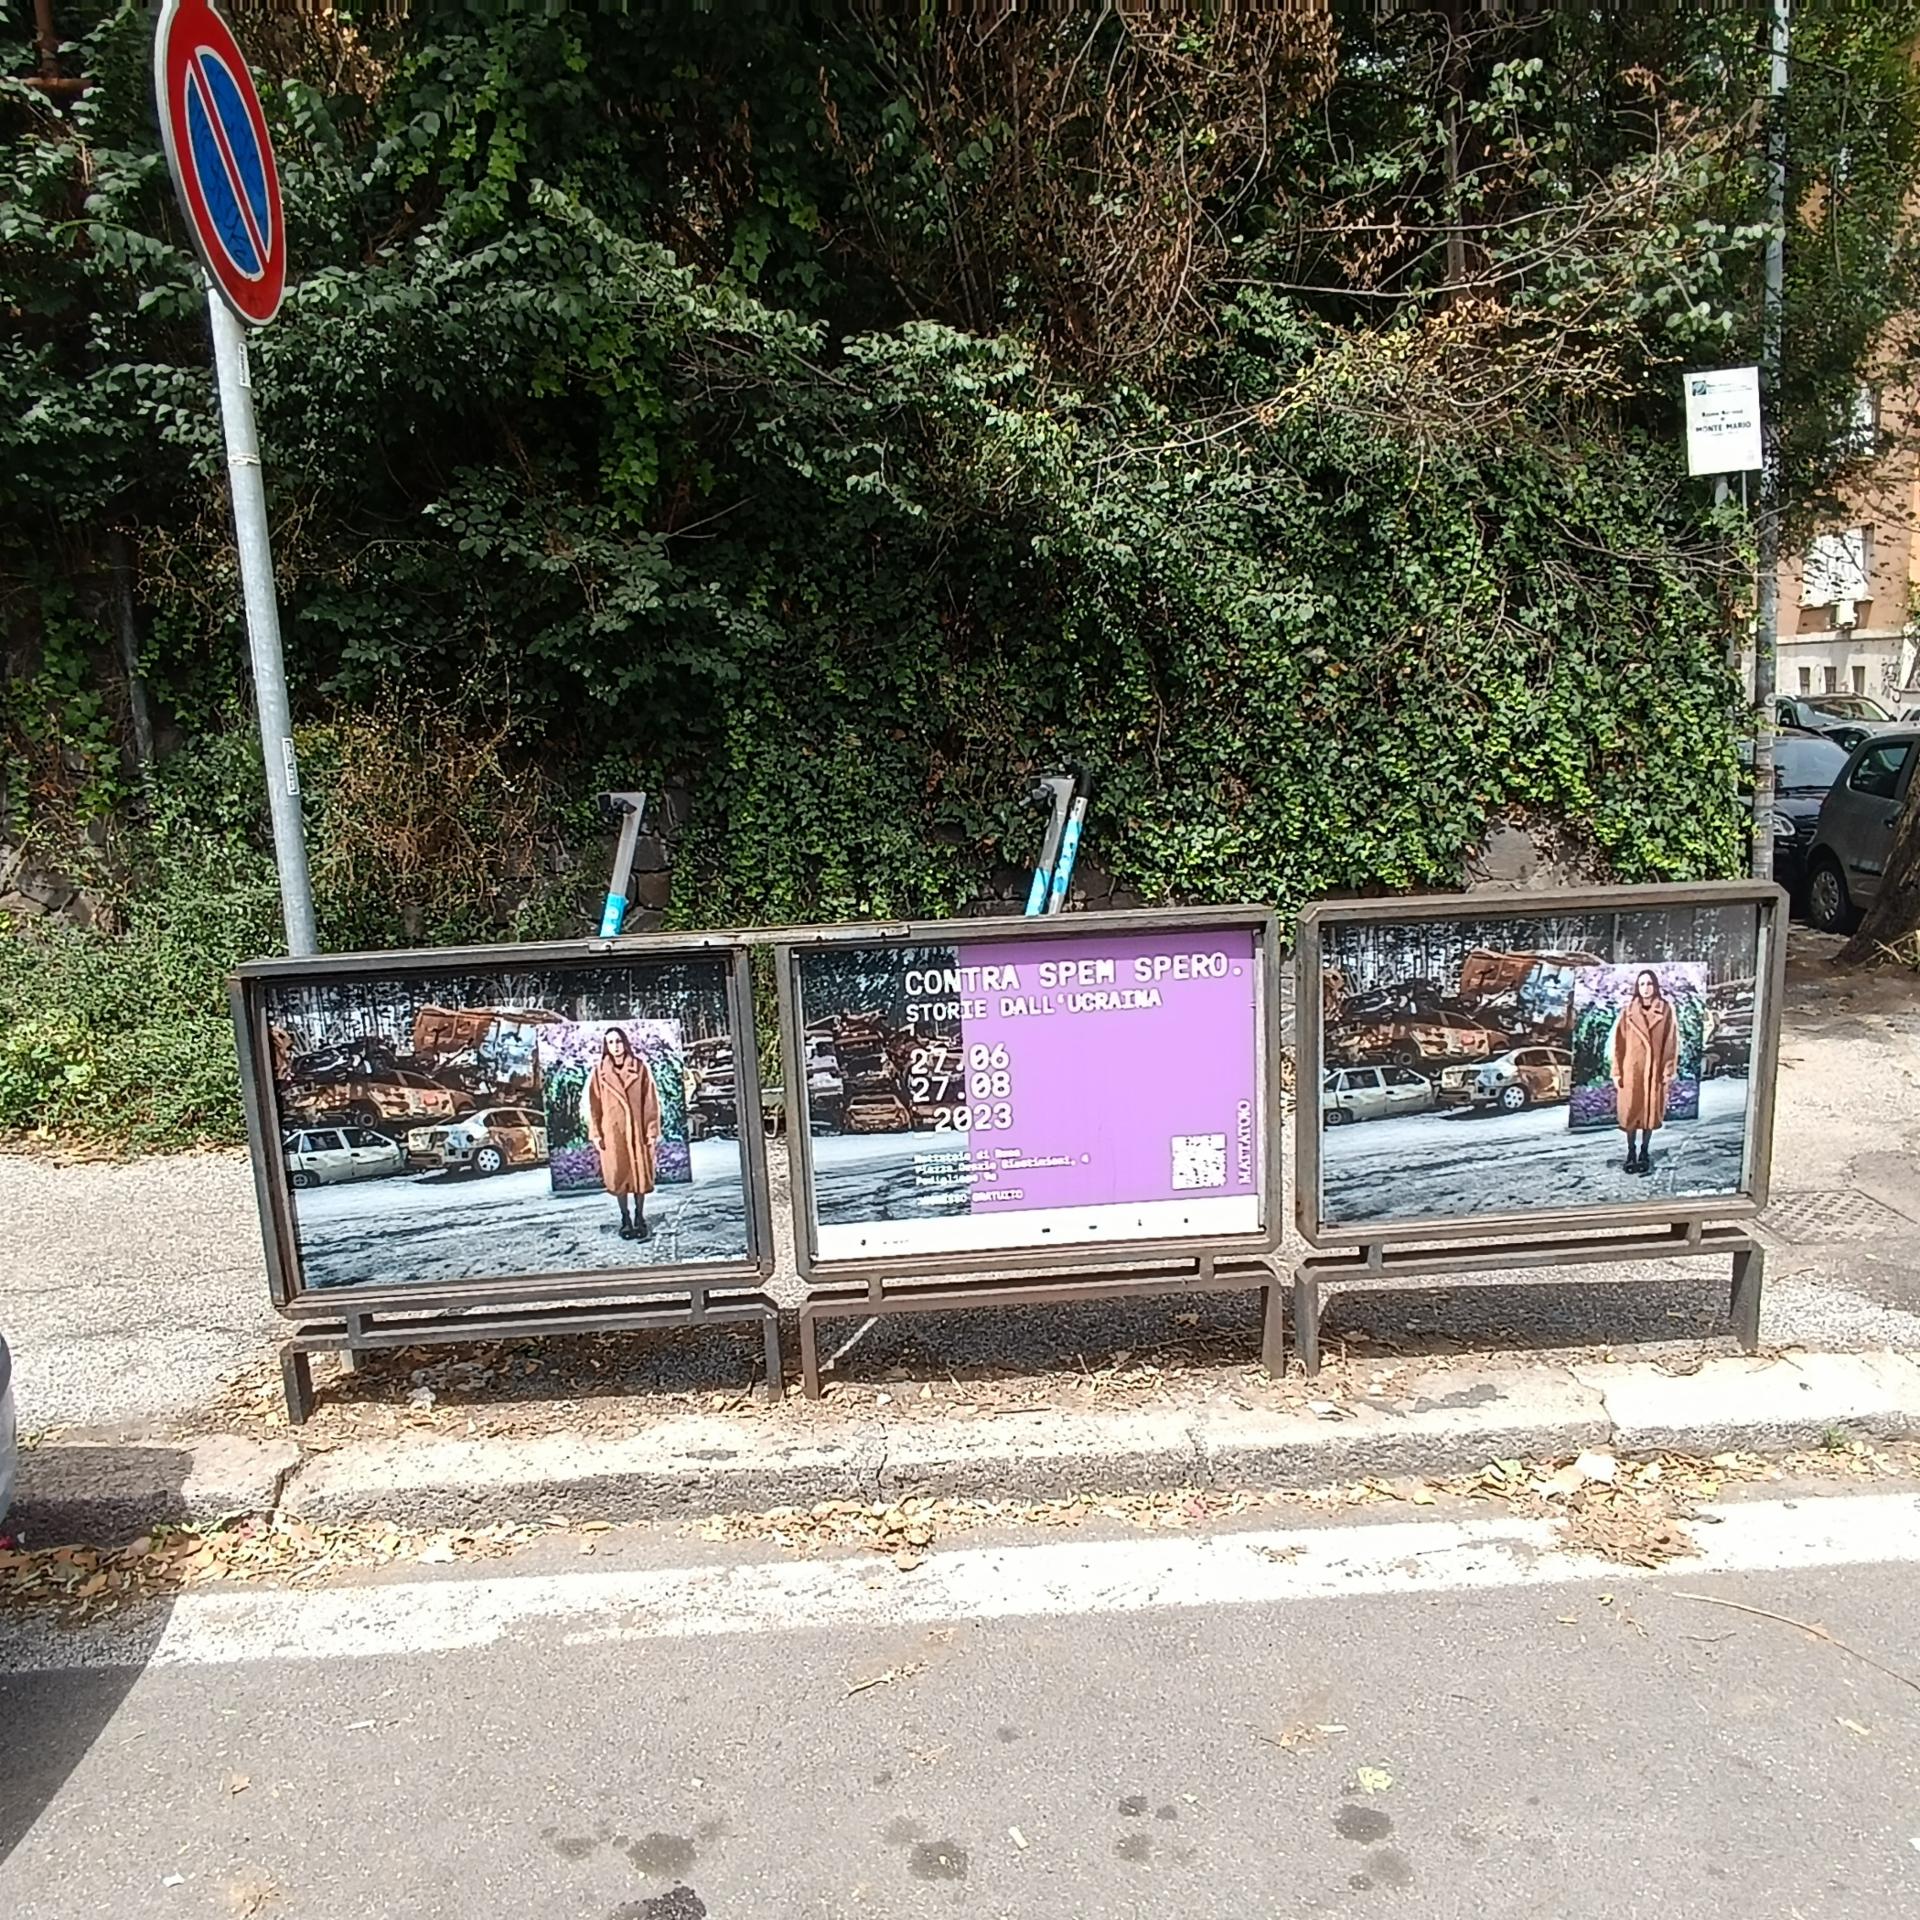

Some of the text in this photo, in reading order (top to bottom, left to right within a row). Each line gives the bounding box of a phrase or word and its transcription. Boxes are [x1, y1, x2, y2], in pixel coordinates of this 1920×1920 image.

[905, 952, 1242, 995] CONTRA SPEM SPERO.
[906, 989, 1163, 1022] STORIE DALL'UCRAINA
[910, 1042, 1010, 1074] 27.06
[912, 1071, 1011, 1103] 27.08
[934, 1102, 1013, 1134] 2023
[1237, 1099, 1252, 1185] MATTATOIO
